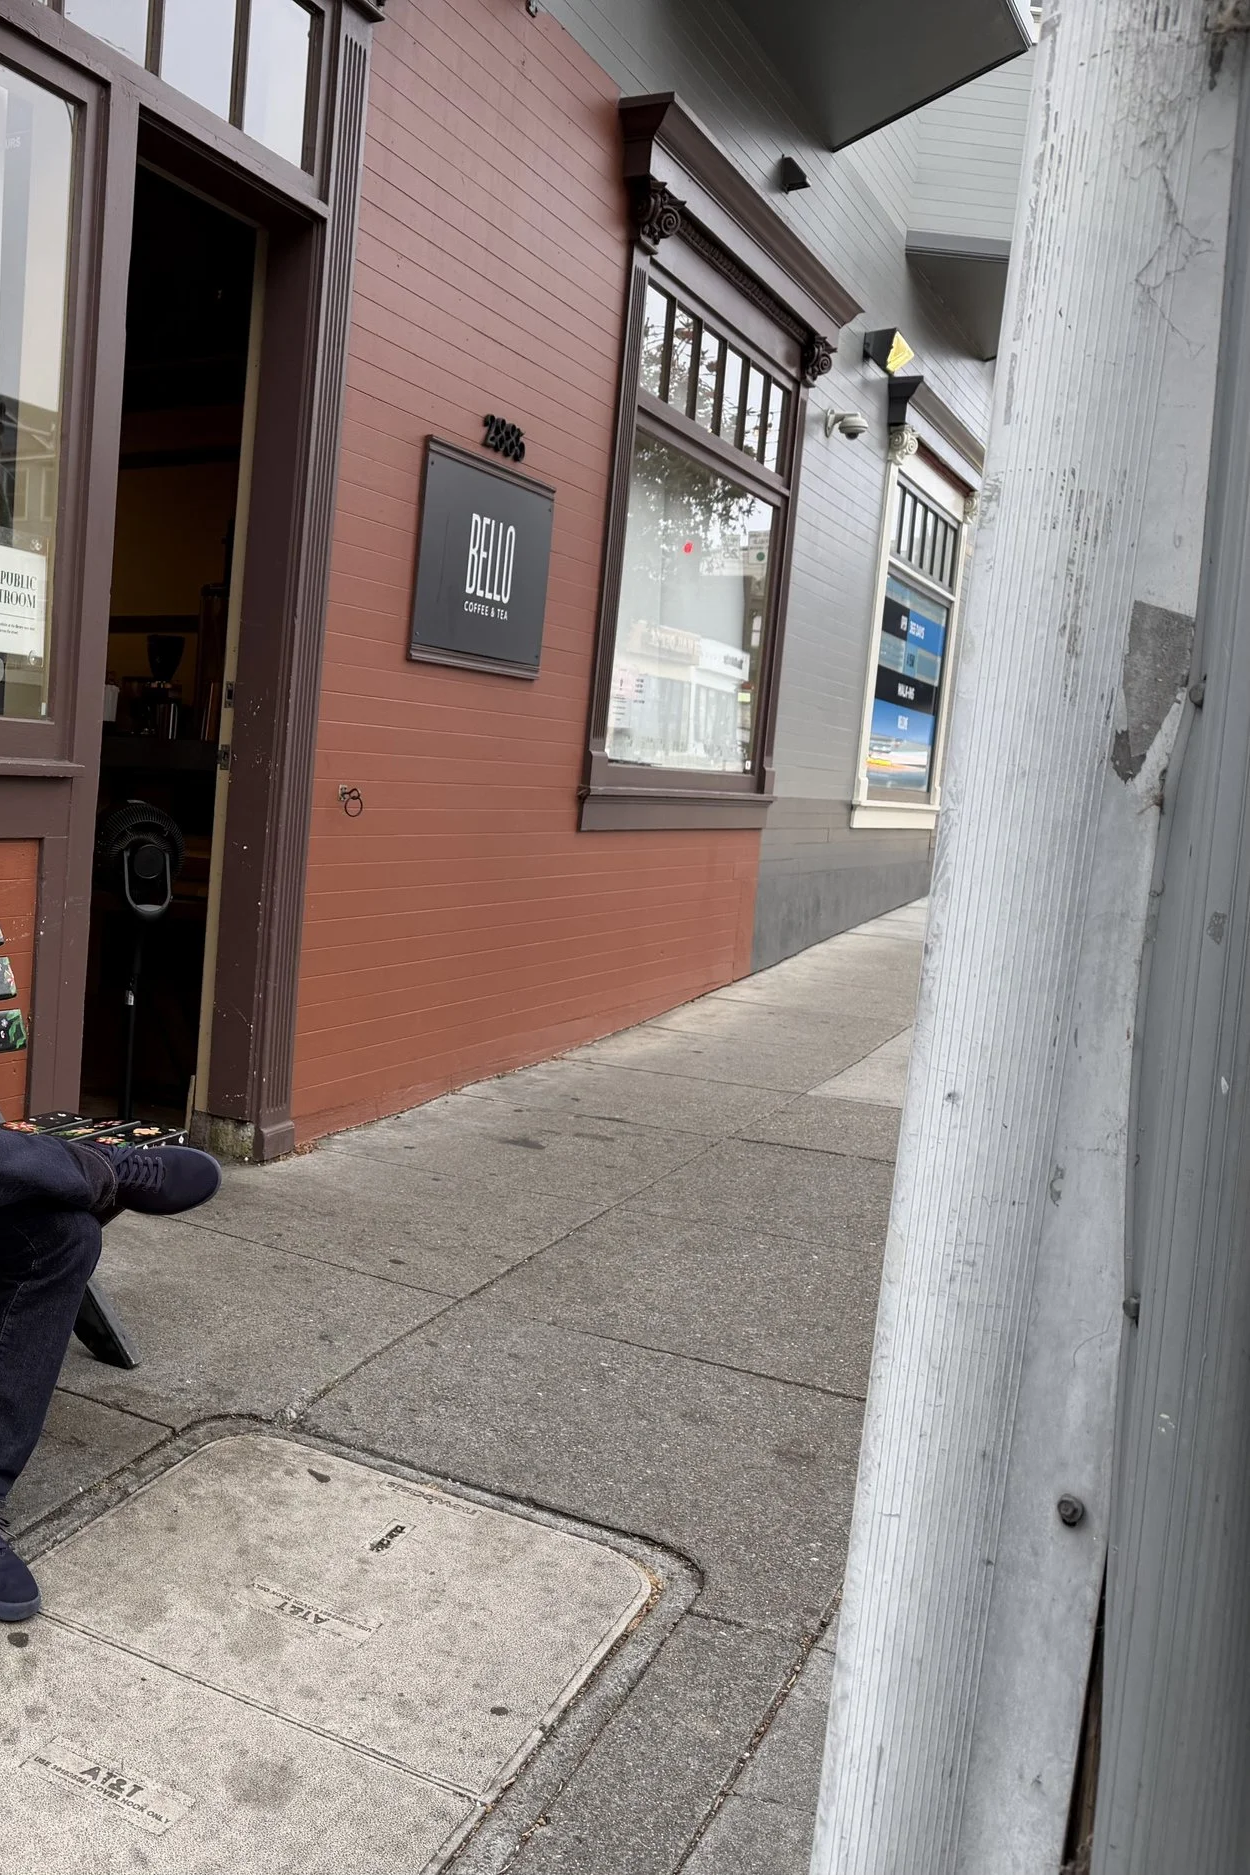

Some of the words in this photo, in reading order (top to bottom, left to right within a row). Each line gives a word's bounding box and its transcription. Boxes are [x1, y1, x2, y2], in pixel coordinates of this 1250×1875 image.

[465, 513, 516, 604] BELLO
[0, 570, 38, 591] PUBLIC
[464, 601, 489, 616] COFFEE
[490, 607, 495, 617] &
[497, 608, 508, 620] TEA
[385, 1481, 483, 1516] newbasis
[275, 1601, 330, 1625] AT&T
[33, 1755, 51, 1768] USE
[90, 1783, 120, 1801] COVER
[120, 1797, 146, 1813] HOOK
[146, 1810, 171, 1824] ONLY
[80, 1766, 144, 1798] AT&T
